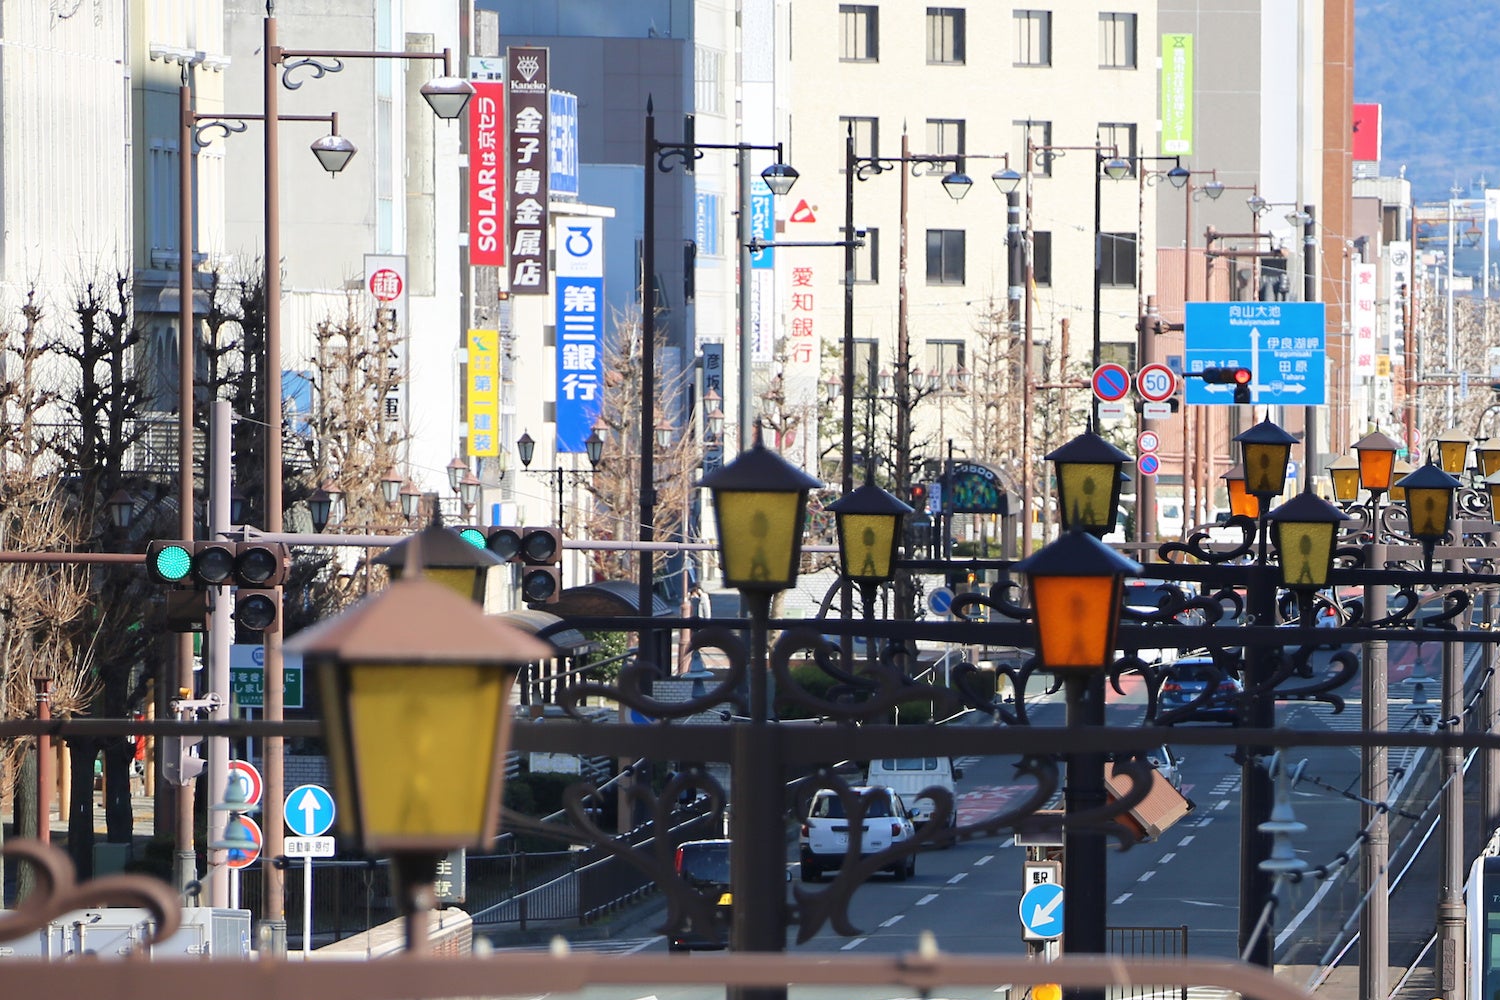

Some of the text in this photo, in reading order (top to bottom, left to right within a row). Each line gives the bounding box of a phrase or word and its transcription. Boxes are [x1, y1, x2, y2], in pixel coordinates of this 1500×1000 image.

[511, 80, 546, 90] Kaneko
[478, 97, 497, 252] SOLARは京セラ
[512, 106, 543, 286] 金子貴金属店
[791, 267, 814, 363] 愛知銀行
[1229, 305, 1281, 318] 向山大池
[562, 285, 598, 400] 第三銀行
[1267, 337, 1319, 349] 伊良湖岬
[1146, 375, 1168, 391] 50
[473, 375, 492, 451] 第一建装
[1142, 436, 1156, 448] 50
